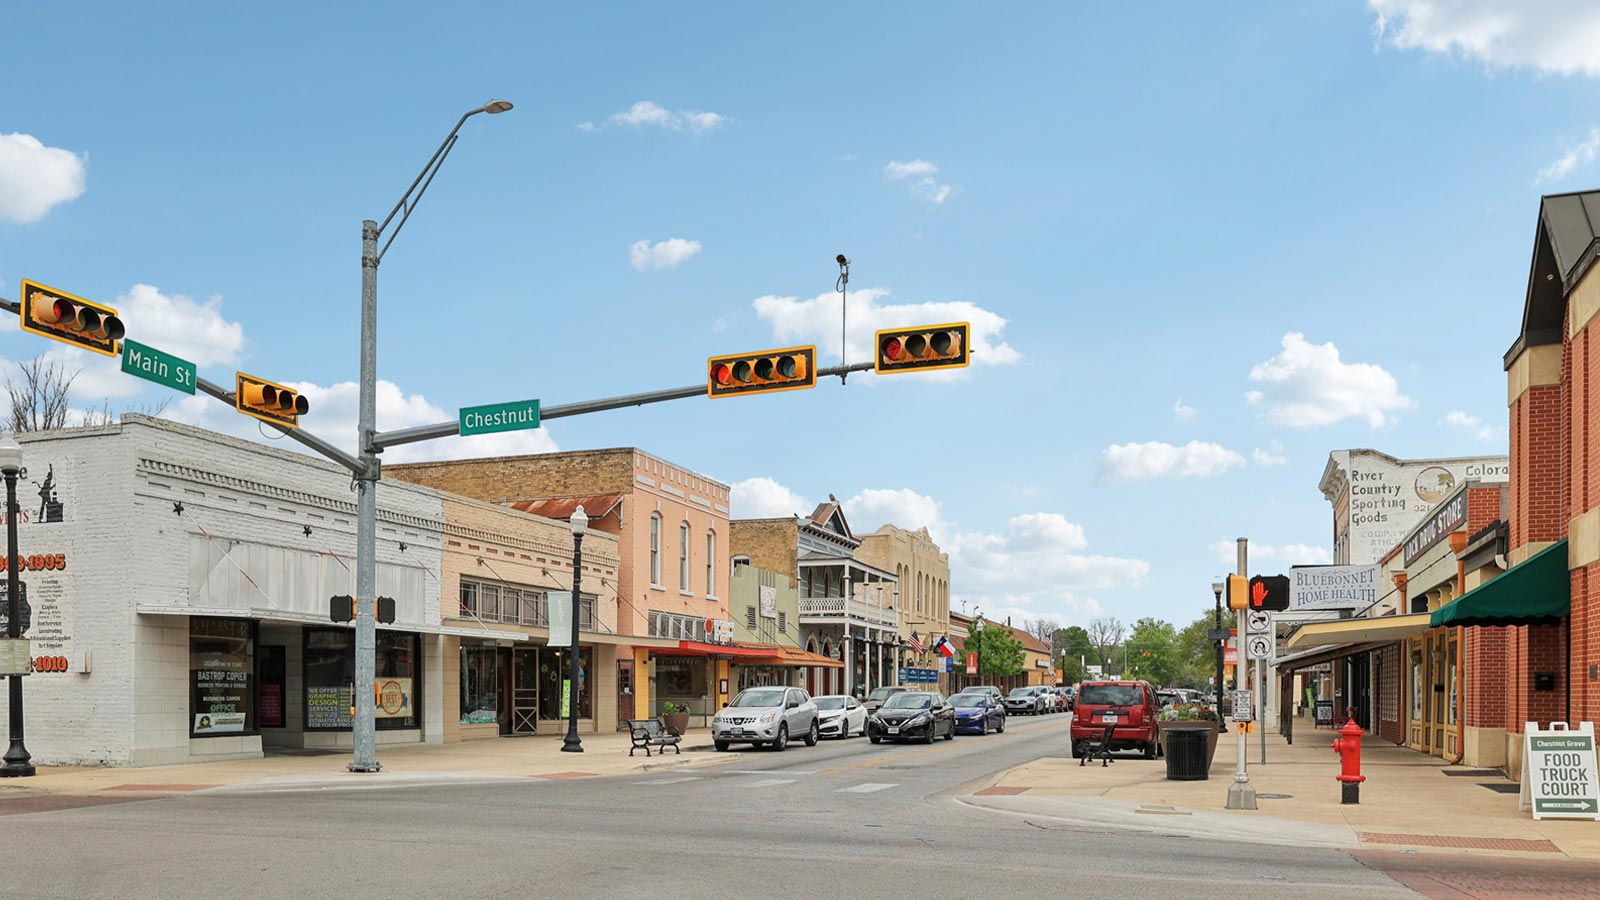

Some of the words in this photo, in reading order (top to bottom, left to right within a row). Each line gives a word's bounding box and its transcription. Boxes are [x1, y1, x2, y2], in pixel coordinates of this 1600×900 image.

[129, 349, 168, 378] Main
[175, 366, 190, 386] St
[465, 407, 533, 428] Chestnut
[1352, 470, 1384, 481] River
[1352, 484, 1401, 497] Country
[1352, 498, 1406, 512] Sporting
[1352, 511, 1388, 527] Goods
[1420, 519, 1437, 550] DRUG
[1437, 496, 1462, 535] STORE
[1296, 568, 1376, 586] BLUEBONNET
[1297, 590, 1329, 606] HOME
[1331, 589, 1376, 602] HEALTH
[197, 671, 225, 680] BASTROP
[227, 671, 247, 681] COPIER
[210, 704, 236, 712] OFFICE
[1537, 740, 1566, 748] Chestnut
[1566, 740, 1586, 748] Grove
[1544, 753, 1581, 767] FOOD
[1540, 768, 1588, 782] TRUCK
[1541, 782, 1588, 796] COURT
